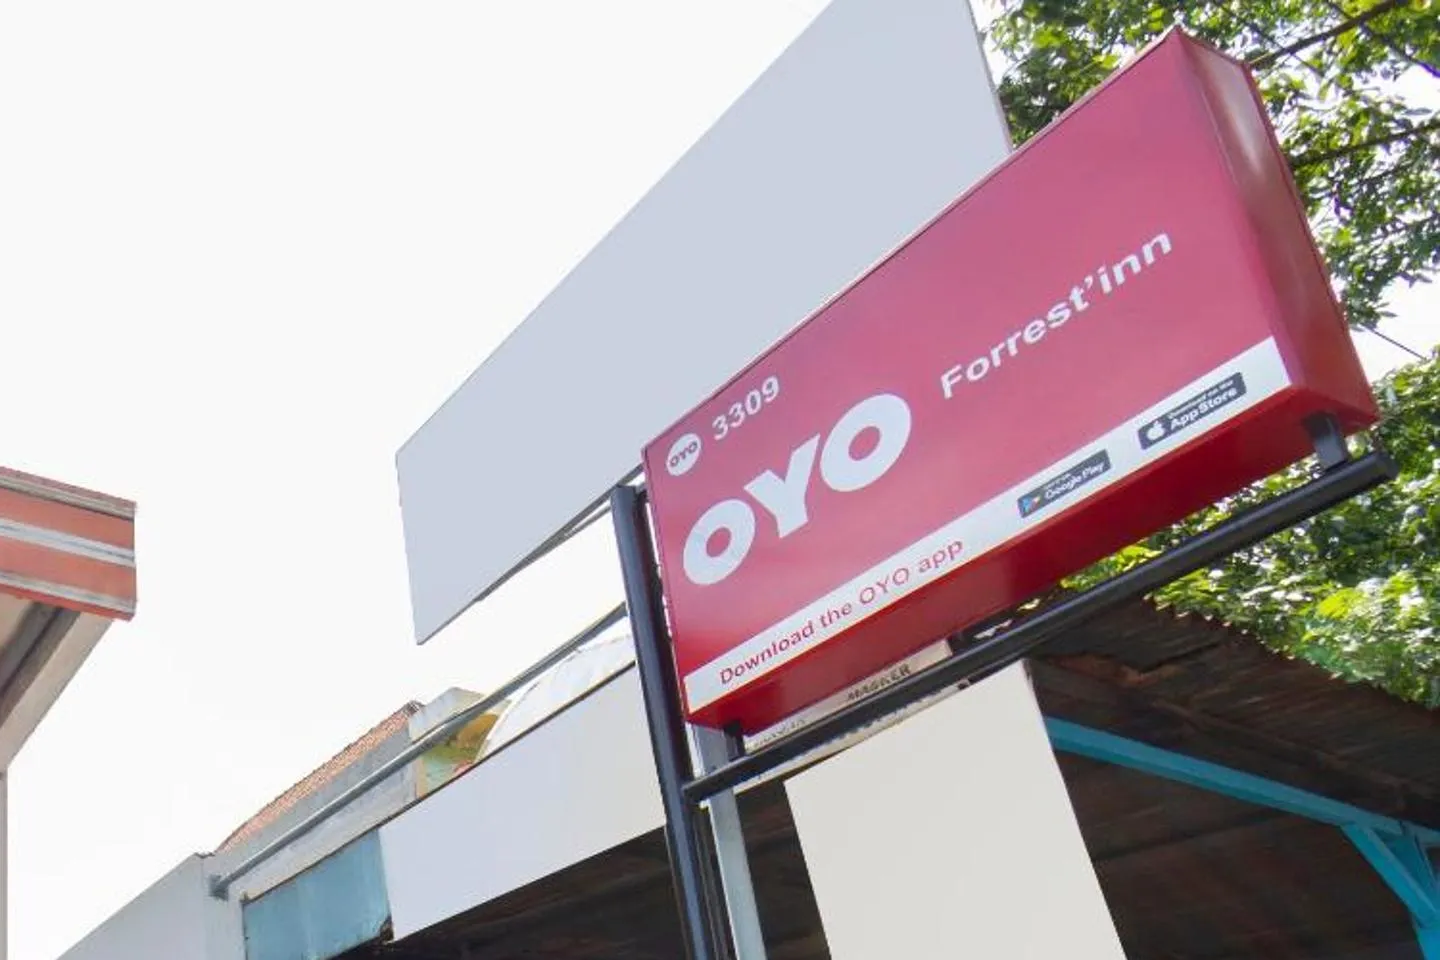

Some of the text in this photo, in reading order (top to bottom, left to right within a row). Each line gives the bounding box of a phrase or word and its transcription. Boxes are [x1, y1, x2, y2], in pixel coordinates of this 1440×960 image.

[940, 233, 1172, 399] Forrest'inn
[670, 376, 779, 467] OYO 3309
[683, 394, 912, 585] OYO
[720, 540, 963, 684] Download the OYO app
